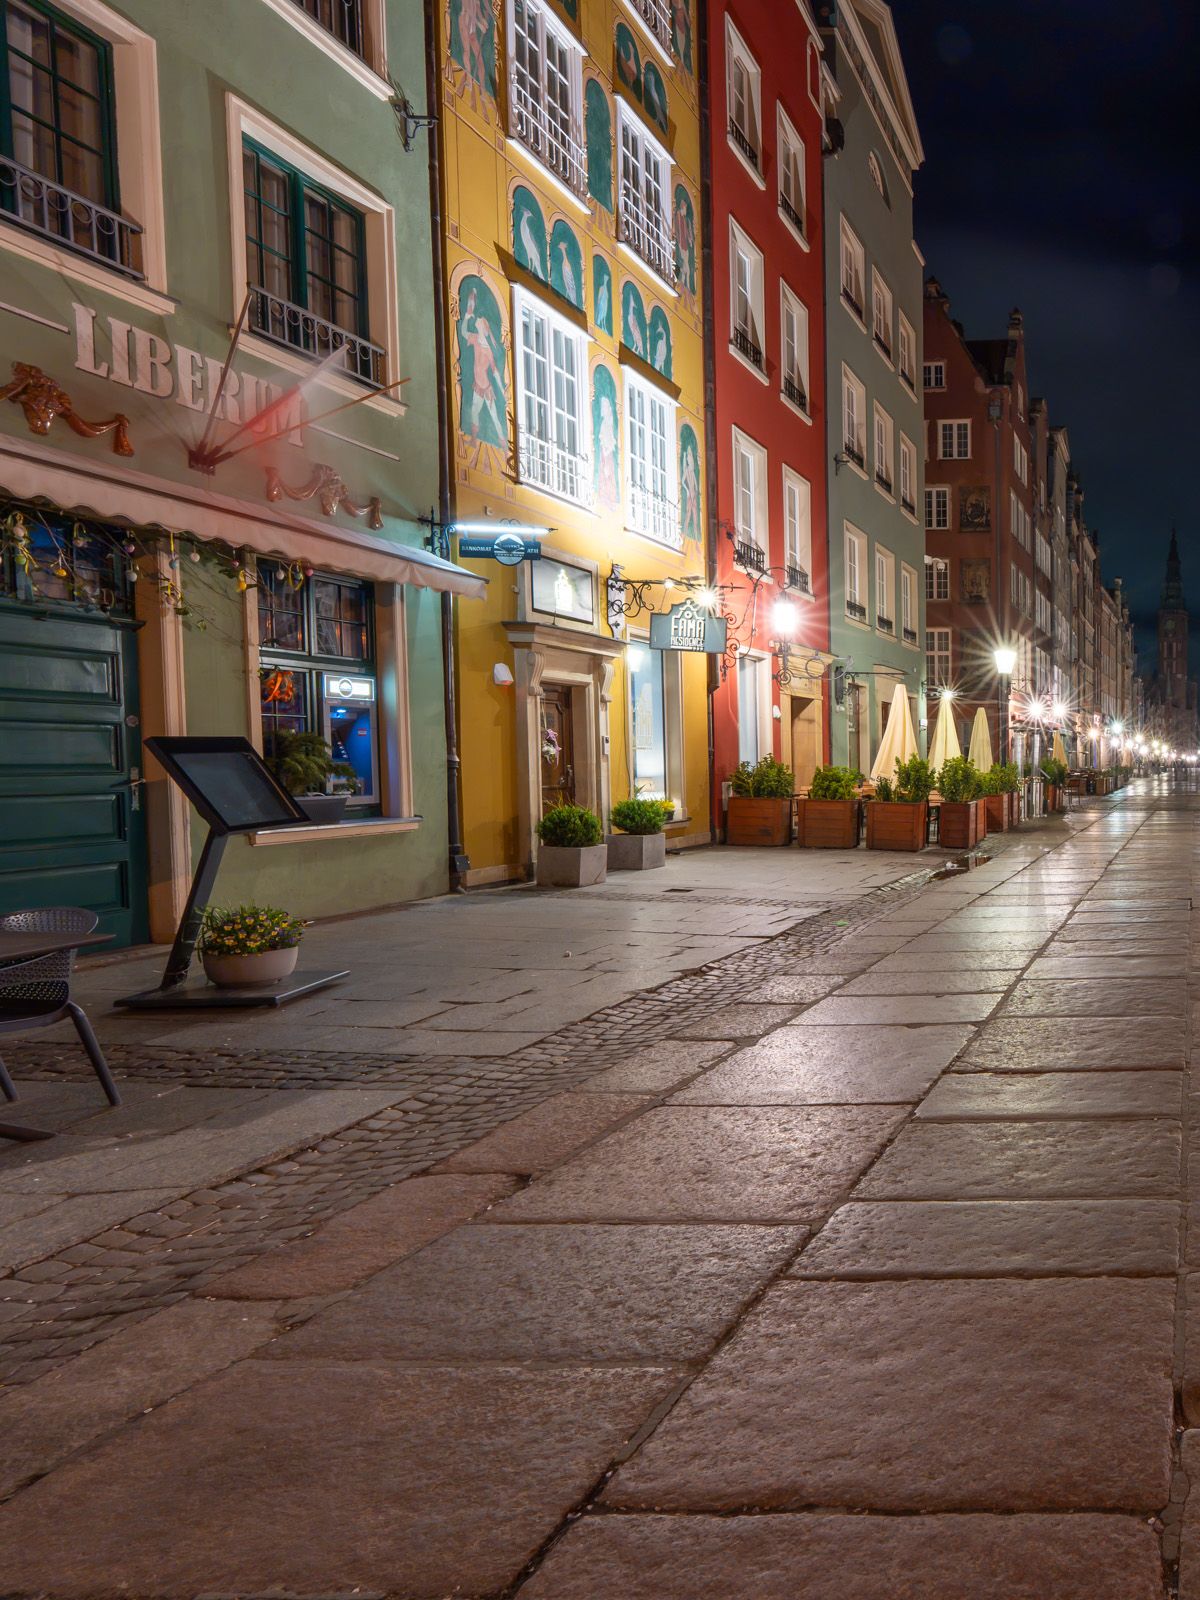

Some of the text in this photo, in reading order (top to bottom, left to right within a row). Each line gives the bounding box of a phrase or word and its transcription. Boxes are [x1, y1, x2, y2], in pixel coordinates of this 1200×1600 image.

[72, 302, 304, 448] LIBERUM
[671, 615, 705, 638] FAMA
[671, 636, 705, 647] RESIDENCE
